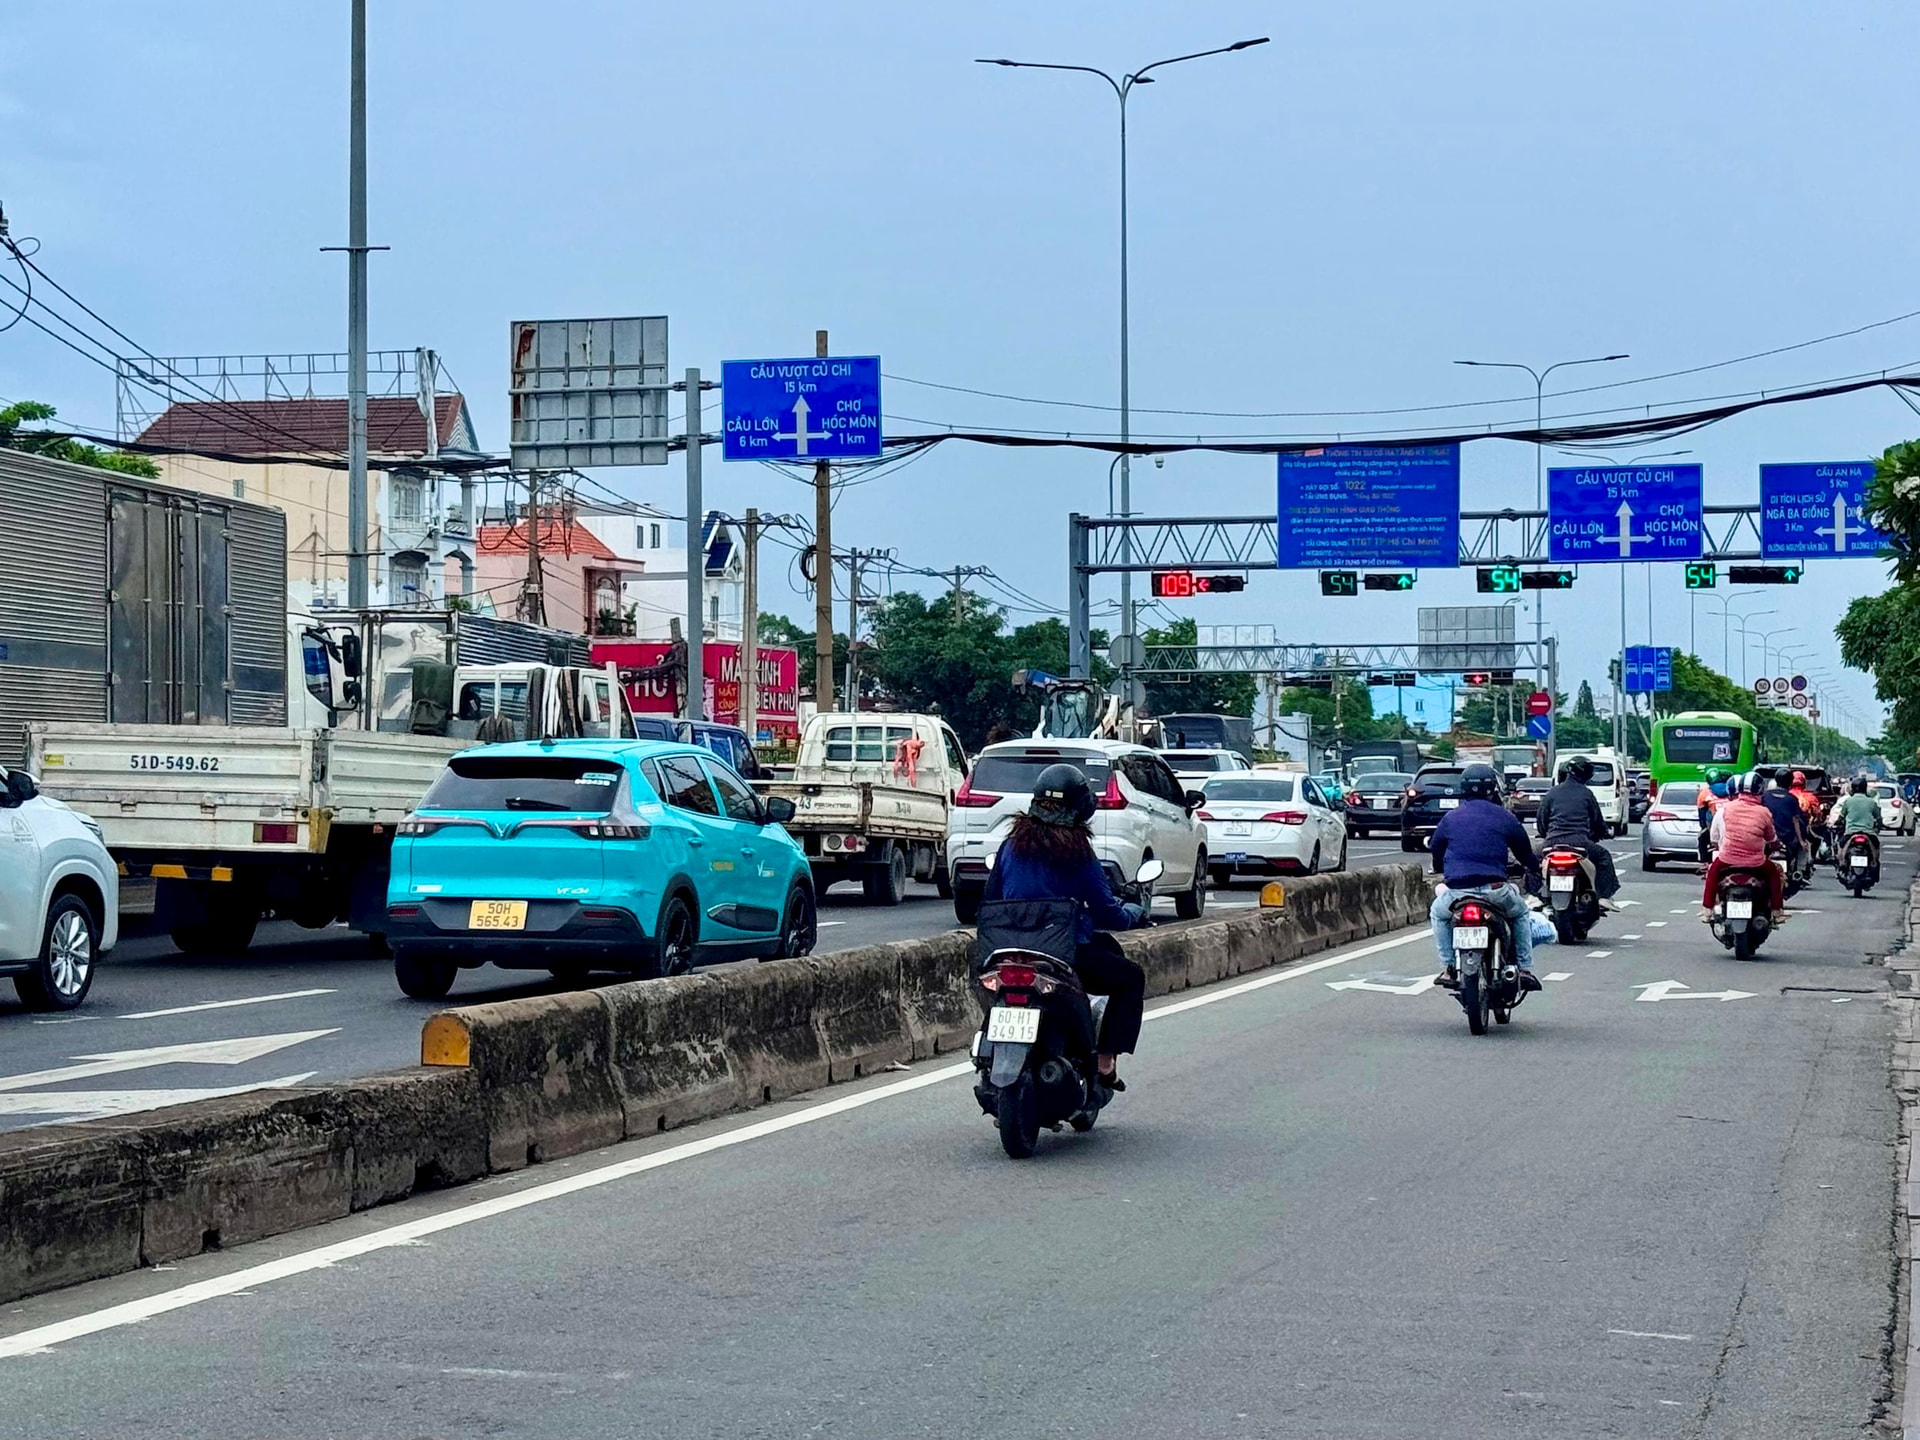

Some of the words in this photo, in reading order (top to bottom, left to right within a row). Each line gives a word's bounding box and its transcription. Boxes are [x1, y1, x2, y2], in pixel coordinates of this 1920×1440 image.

[777, 364, 808, 380] VƯỢT
[812, 361, 829, 377] CỦ
[831, 364, 851, 376] CHI
[784, 381, 795, 393] 15
[798, 380, 817, 392] km
[837, 398, 862, 413] CHỢ
[754, 416, 779, 431] LỚN
[822, 415, 847, 429] HÓC
[849, 413, 877, 428] MÔN
[739, 436, 746, 447] 6
[749, 435, 768, 447] km
[839, 433, 844, 444] 1
[847, 432, 865, 444] km
[1602, 471, 1633, 486] VƯỢT
[1636, 468, 1652, 483] CỦ
[1655, 470, 1674, 483] CHI
[1834, 468, 1847, 477] AN
[1344, 480, 1367, 490] 1022
[1607, 487, 1618, 498] 15
[1621, 487, 1639, 498] km
[1770, 495, 1779, 505] DI
[1780, 493, 1796, 504] TÍCH
[1659, 504, 1684, 518] CHỢ
[1787, 507, 1801, 519] BA
[1644, 518, 1669, 532] HÓC
[1785, 523, 1790, 532] 3
[1563, 538, 1570, 549] 6
[1573, 538, 1591, 549] km
[1661, 536, 1666, 546] 1
[1669, 536, 1687, 546] km
[1491, 569, 1518, 591] 54
[1687, 566, 1714, 587] 54
[1161, 574, 1190, 595] 109
[1330, 575, 1354, 593] 54
[721, 644, 743, 684] MẮ
[130, 755, 220, 771] 51D-549.62
[488, 903, 512, 915] 50H
[476, 915, 519, 928] 565.43
[998, 1010, 1031, 1025] 60-H1
[991, 1025, 1034, 1040] 349.15
